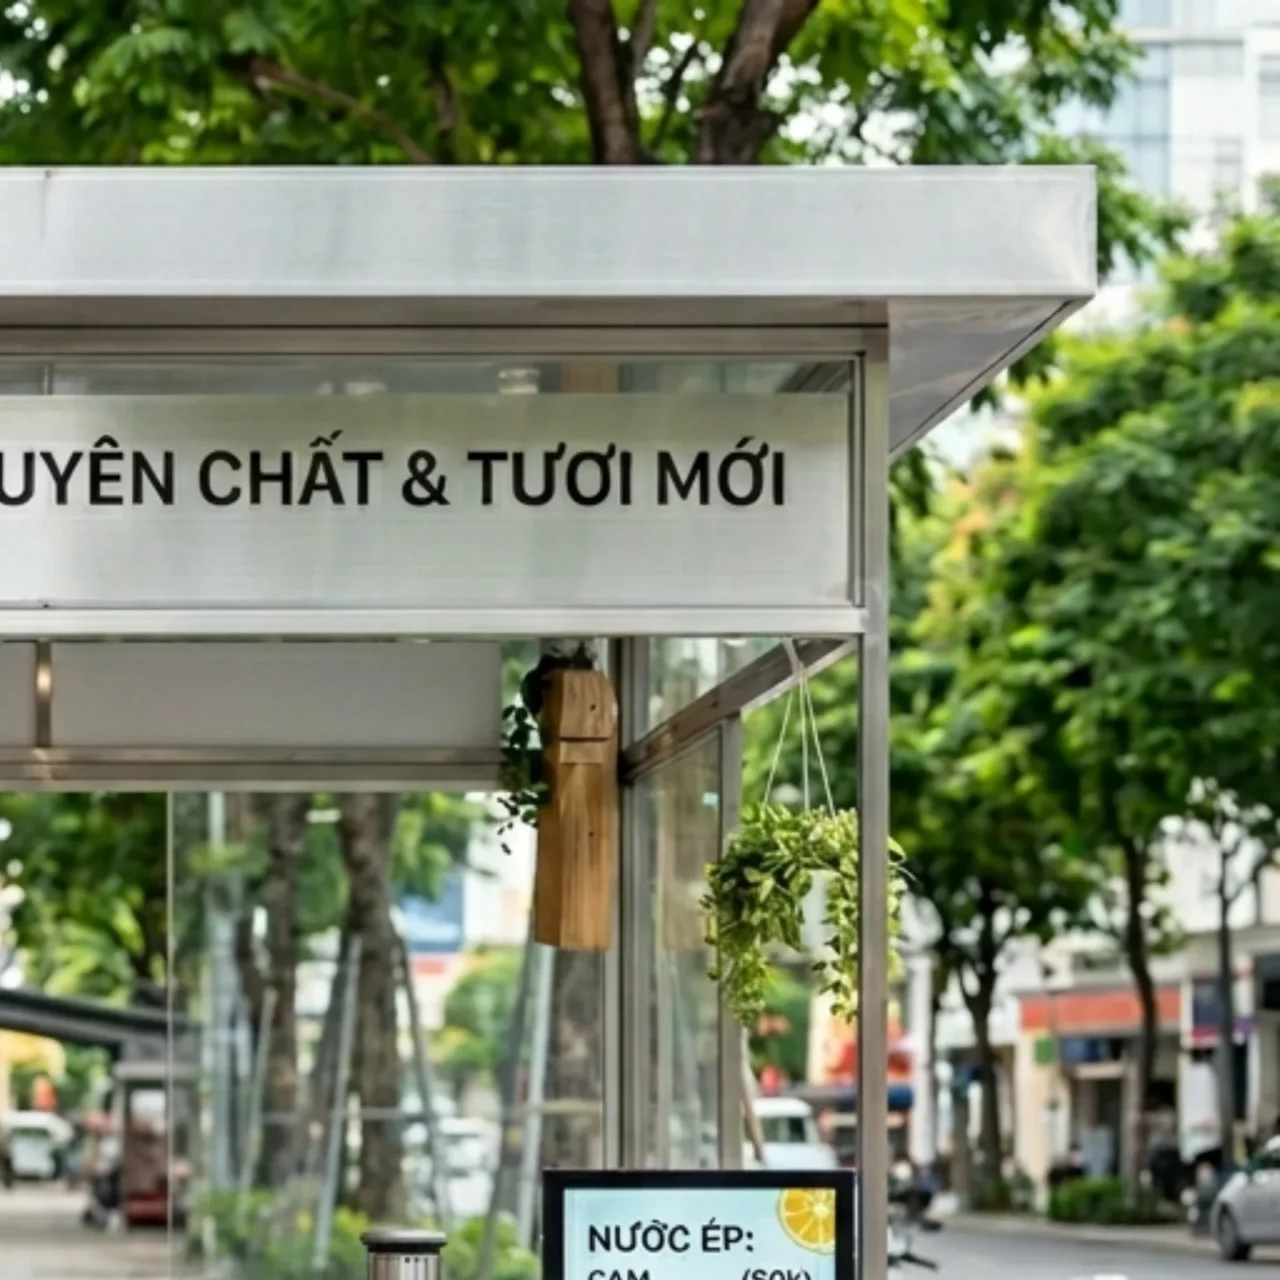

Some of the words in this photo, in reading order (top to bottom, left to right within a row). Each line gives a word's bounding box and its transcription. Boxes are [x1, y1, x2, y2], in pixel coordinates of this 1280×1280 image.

[199, 429, 384, 506] CHẤT
[401, 449, 450, 507] &
[466, 441, 633, 507] TƯƠI
[657, 436, 785, 507] MỚI
[700, 1217, 755, 1253] ÉP:
